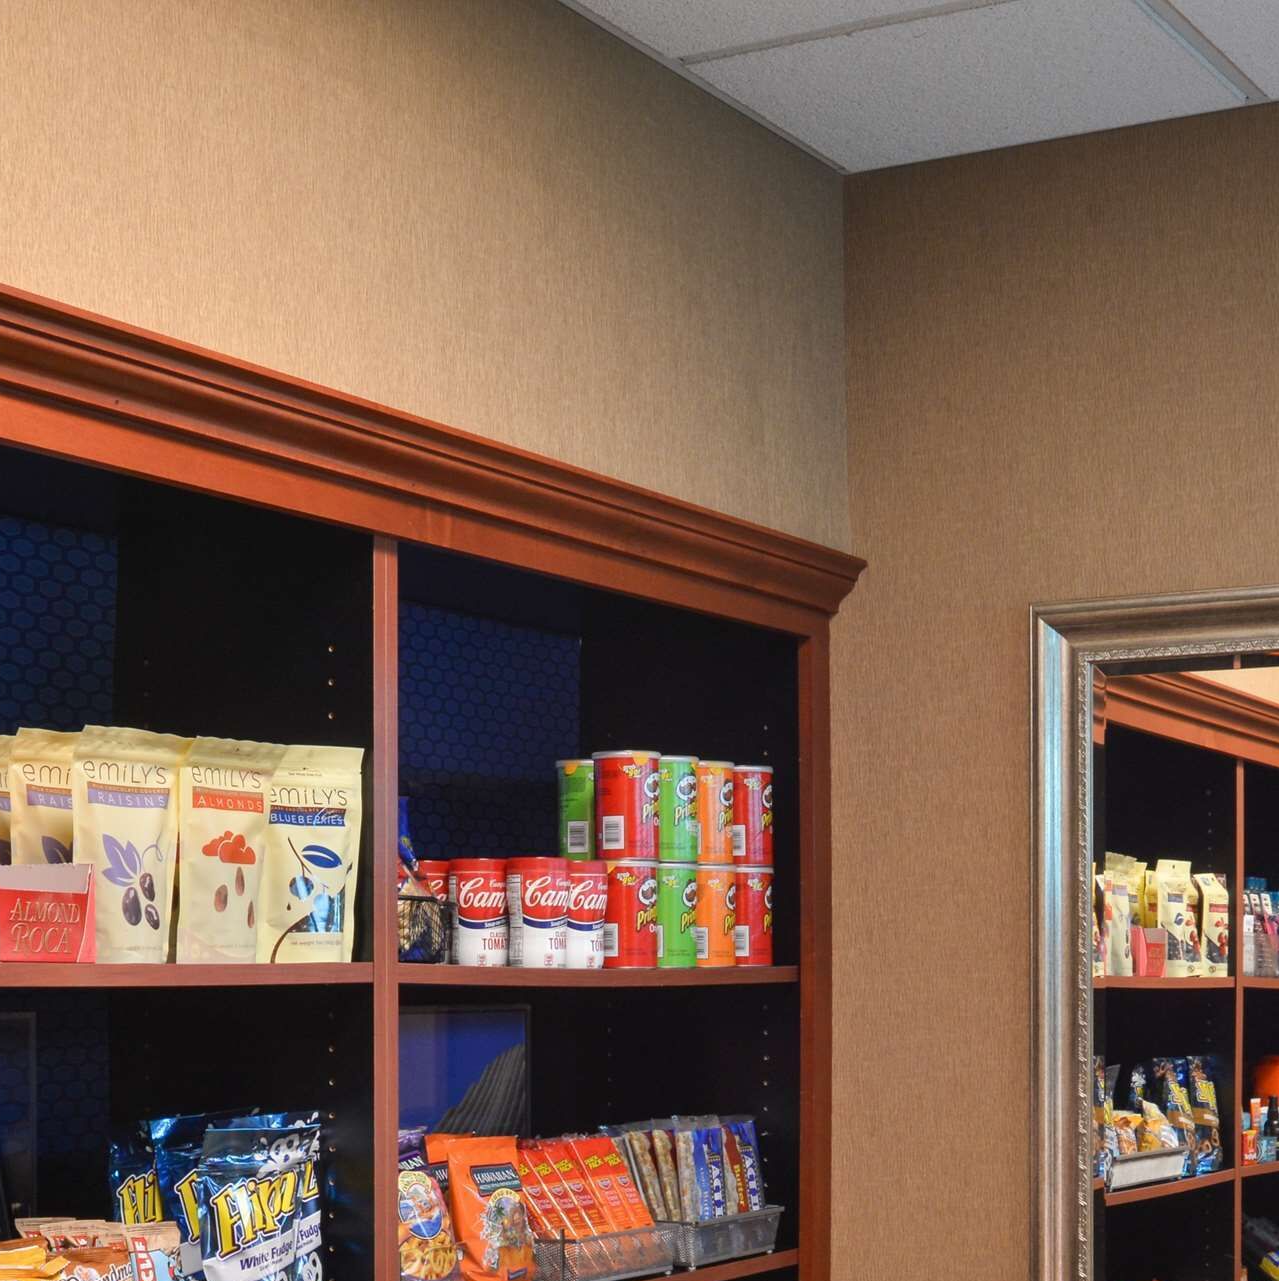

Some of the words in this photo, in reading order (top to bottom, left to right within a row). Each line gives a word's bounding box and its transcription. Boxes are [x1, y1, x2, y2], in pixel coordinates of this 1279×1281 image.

[97, 792, 167, 808] RAISINS
[197, 795, 263, 812] ALMONDS
[270, 812, 344, 825] BLUEBERRIES
[9, 897, 81, 924] ALMOND
[10, 922, 73, 955] ROCA
[743, 1154, 757, 1190] ACT
[134, 1240, 156, 1281] CLIF
[240, 1251, 270, 1271] White
[271, 1240, 294, 1258] Fudge
